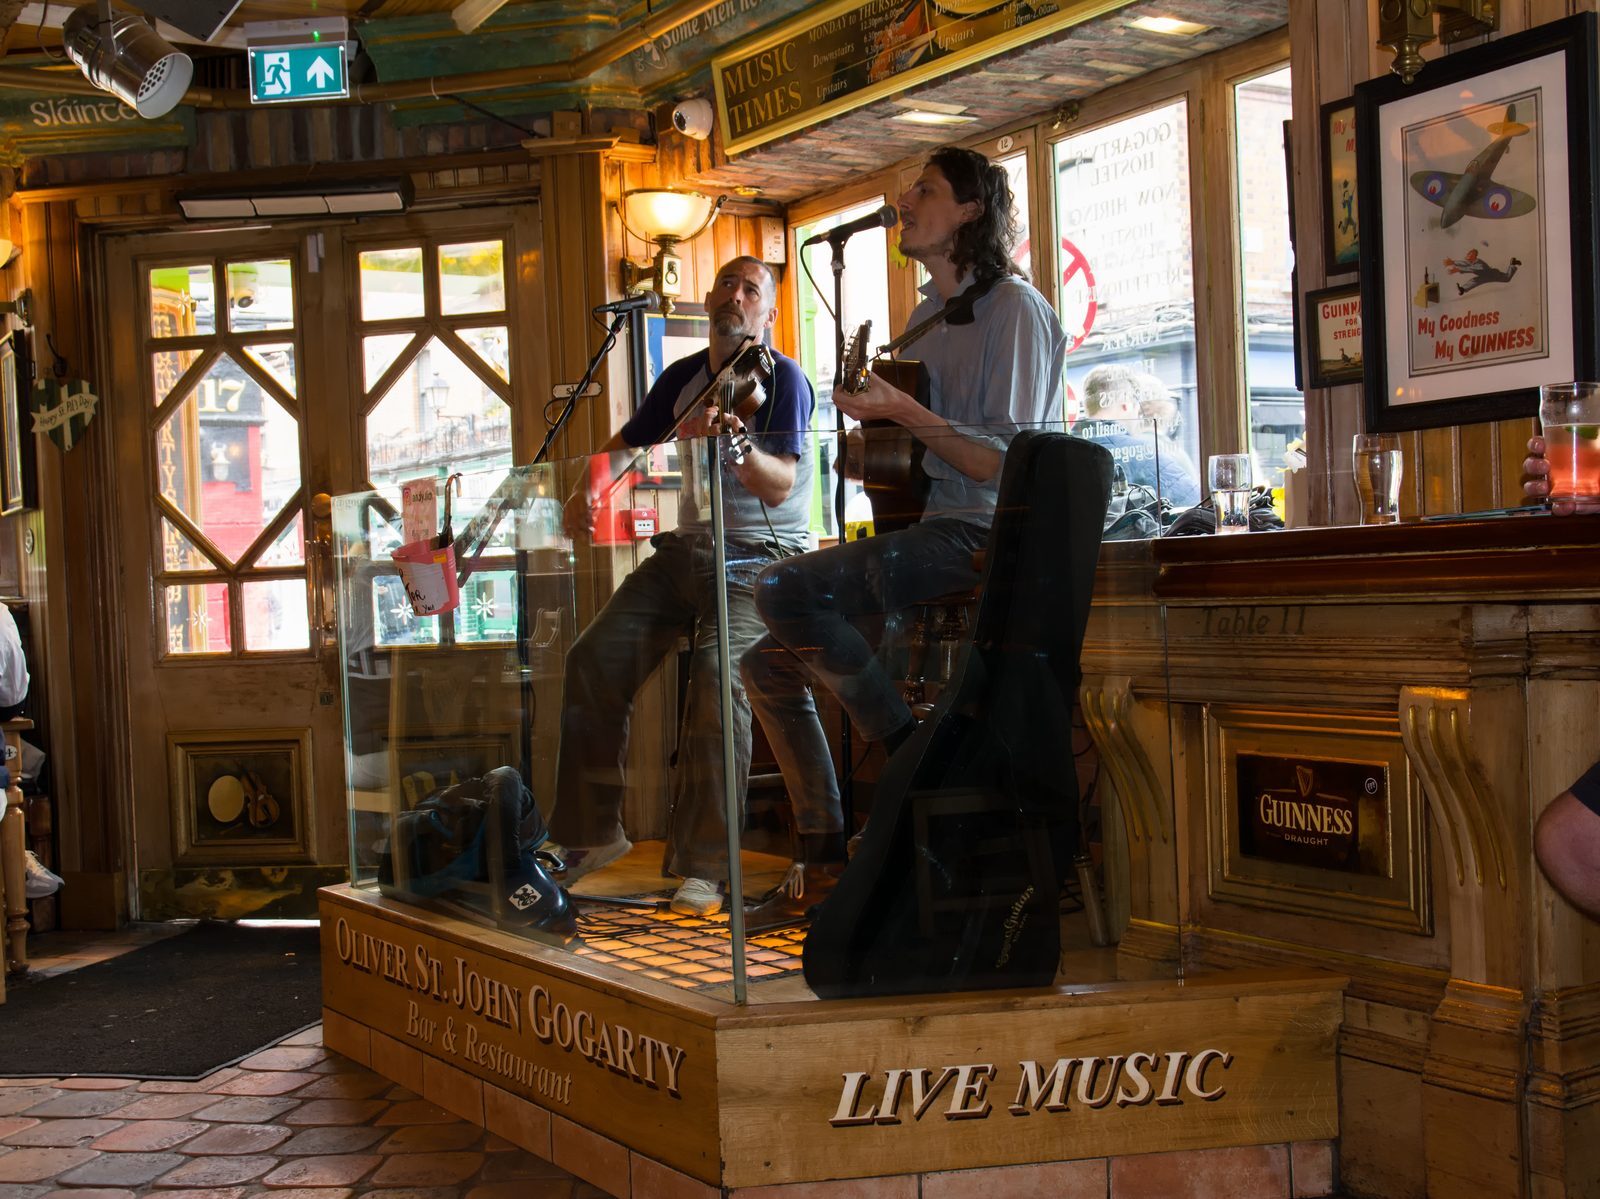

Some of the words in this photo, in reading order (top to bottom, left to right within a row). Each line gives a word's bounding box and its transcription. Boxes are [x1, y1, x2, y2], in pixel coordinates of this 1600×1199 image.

[661, 19, 700, 50] Some
[703, 2, 737, 31] Men
[808, 15, 849, 42] MONDAY
[859, 0, 904, 21] THURSD
[813, 43, 855, 68] Downstairs
[938, 27, 975, 52] Upstairs
[724, 42, 797, 98] MUSIC
[816, 80, 848, 101] Upstairs
[729, 81, 802, 133] TIMES
[1345, 138, 1356, 152] M
[1322, 301, 1361, 320] GUINN
[1345, 317, 1357, 327] FOR
[1418, 317, 1435, 338] My
[1439, 310, 1500, 333] Goodness
[1333, 327, 1361, 340] STRENG
[1435, 340, 1454, 361] My
[1458, 326, 1536, 357] GUINNESS
[199, 378, 247, 413] 17
[1202, 606, 1271, 636] Table
[1260, 794, 1353, 835] GUINNESS
[1284, 833, 1329, 846] DRAUGHT
[335, 917, 412, 989] OLIVER
[453, 956, 523, 1034] JOHN
[528, 984, 685, 1098] GOGARTY
[405, 1000, 437, 1046] Bar
[442, 1016, 458, 1056] &
[464, 1023, 573, 1105] Restaurant
[828, 1063, 998, 1127] LIVE
[1007, 1048, 1233, 1115] MUSIC
